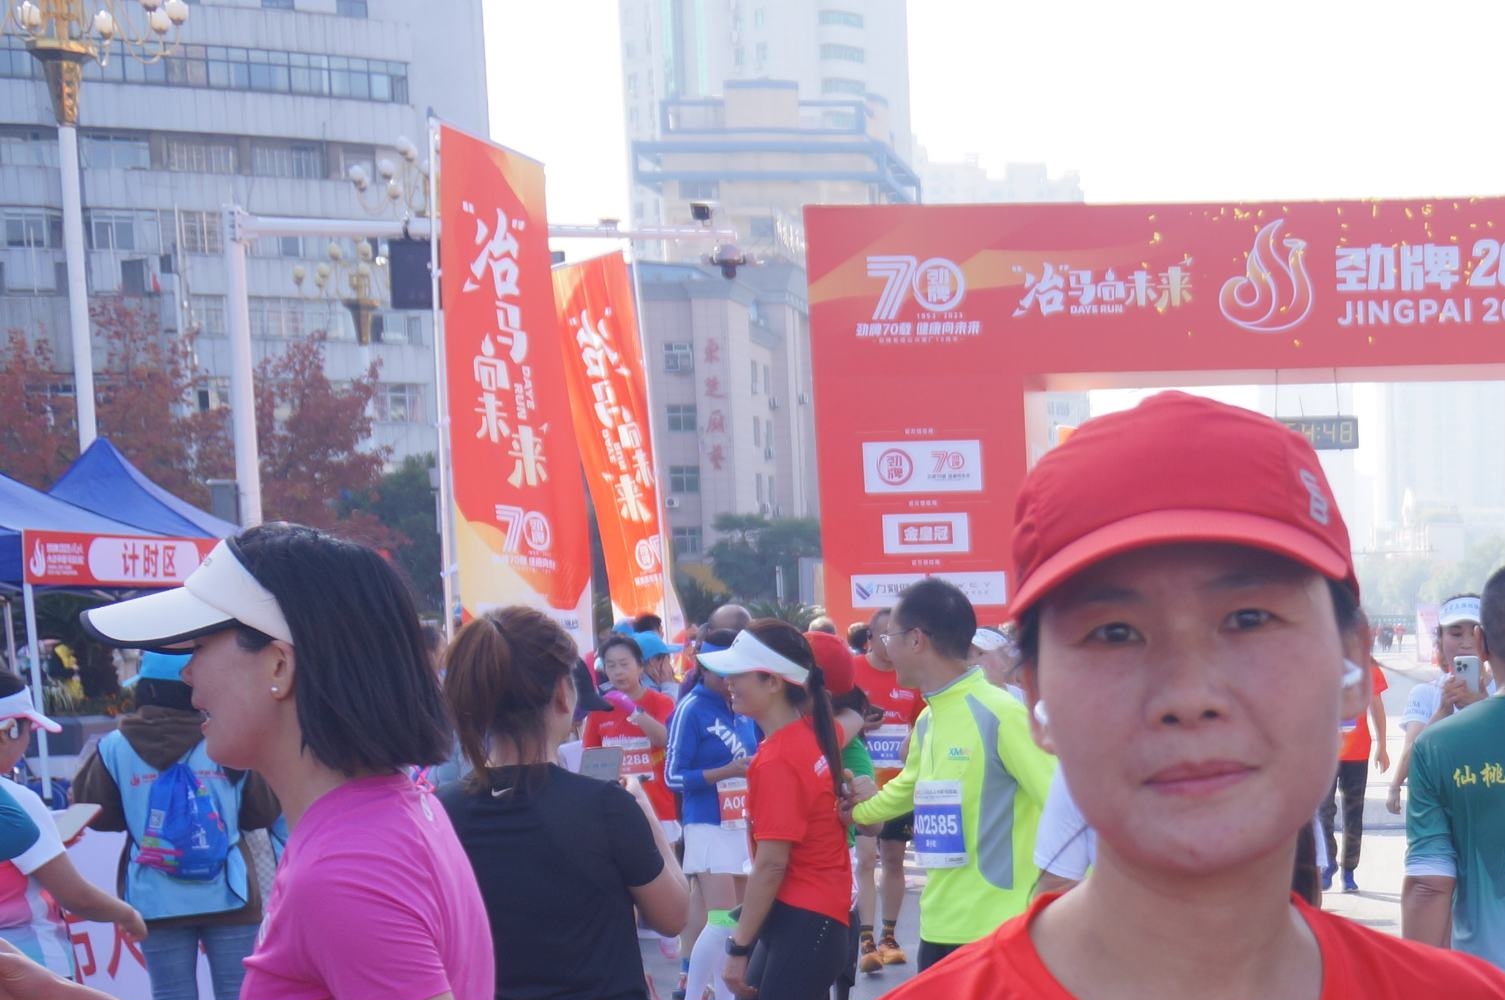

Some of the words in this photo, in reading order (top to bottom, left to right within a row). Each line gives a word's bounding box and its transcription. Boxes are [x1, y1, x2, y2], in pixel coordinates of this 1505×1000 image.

[1335, 244, 1459, 292] 劲牌
[1101, 304, 1123, 313] RUN
[1337, 299, 1471, 326] JINGPAI
[514, 383, 529, 421] RUN
[121, 543, 176, 577] 计时区
[914, 815, 958, 836] A02585
